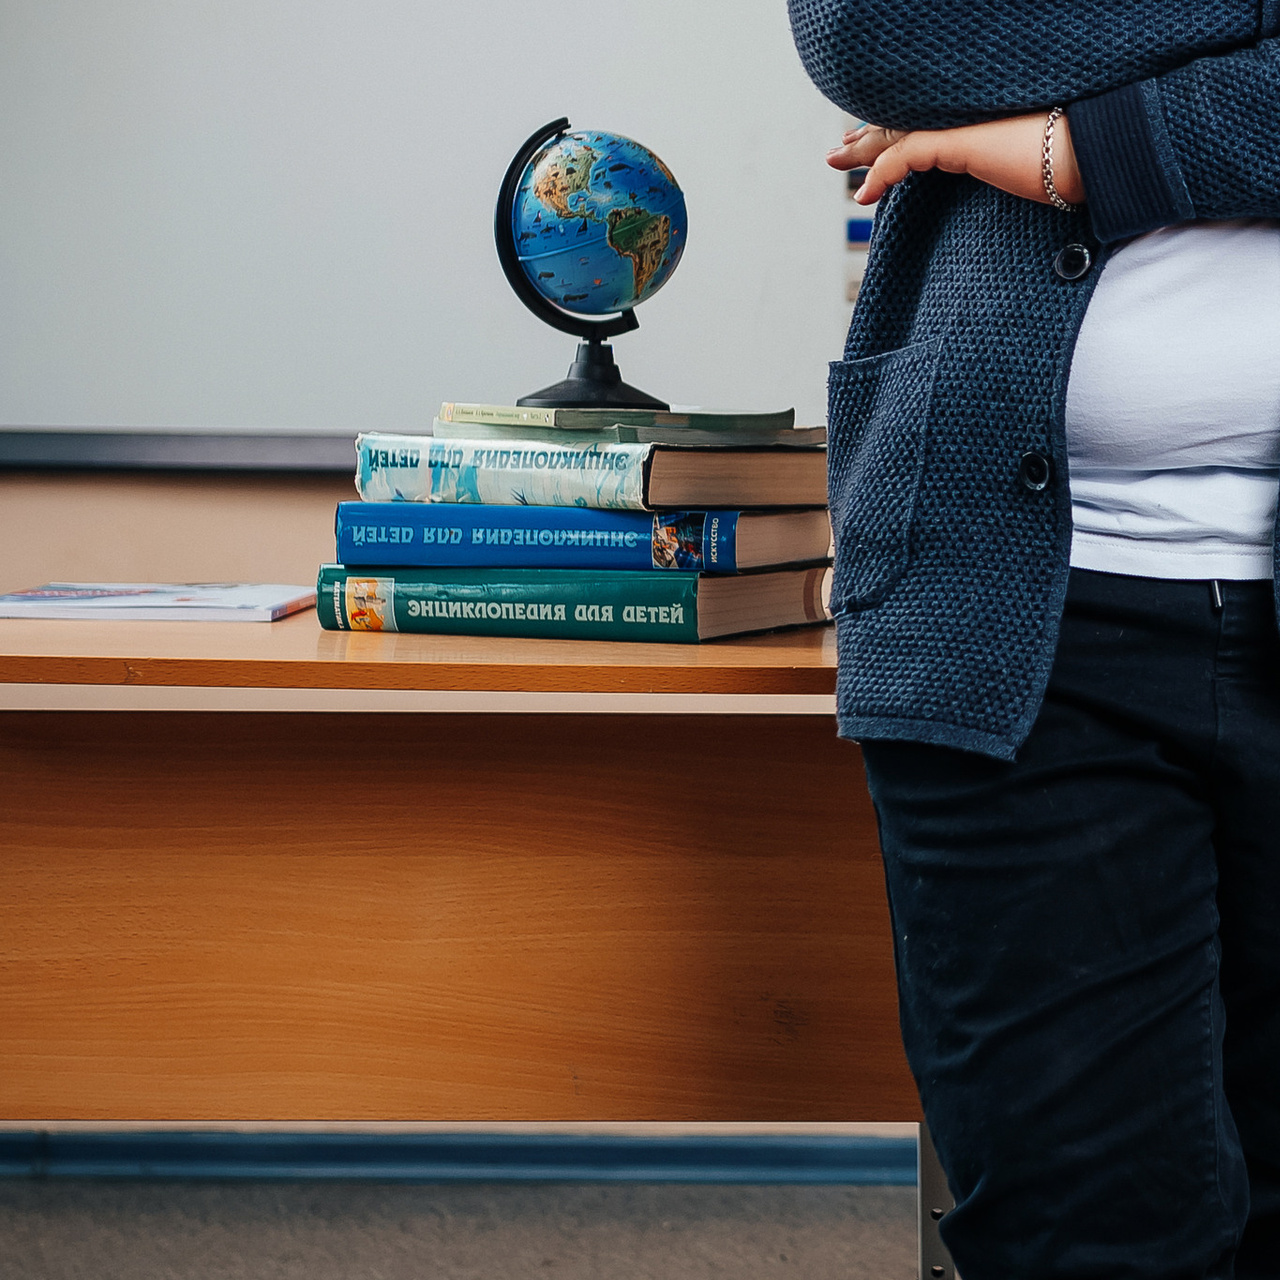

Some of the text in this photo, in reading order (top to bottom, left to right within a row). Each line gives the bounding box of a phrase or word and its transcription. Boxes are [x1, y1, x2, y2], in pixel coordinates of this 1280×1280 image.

[368, 448, 629, 472] ЭНЦИКЛОПЕДИЯ ДЛЯ ДЕТЕЙ
[352, 525, 638, 548] ЭНЦИКЛОПЕДИЯ ДЛЯ ДЕТЕЙ
[710, 517, 719, 563] ИСКУССТВО
[334, 581, 344, 629] МАТЕМАТИКА
[407, 599, 684, 625] ЭНЦИКЛОПЕДИЯ ДЛЯ ДЕТЕЙ
